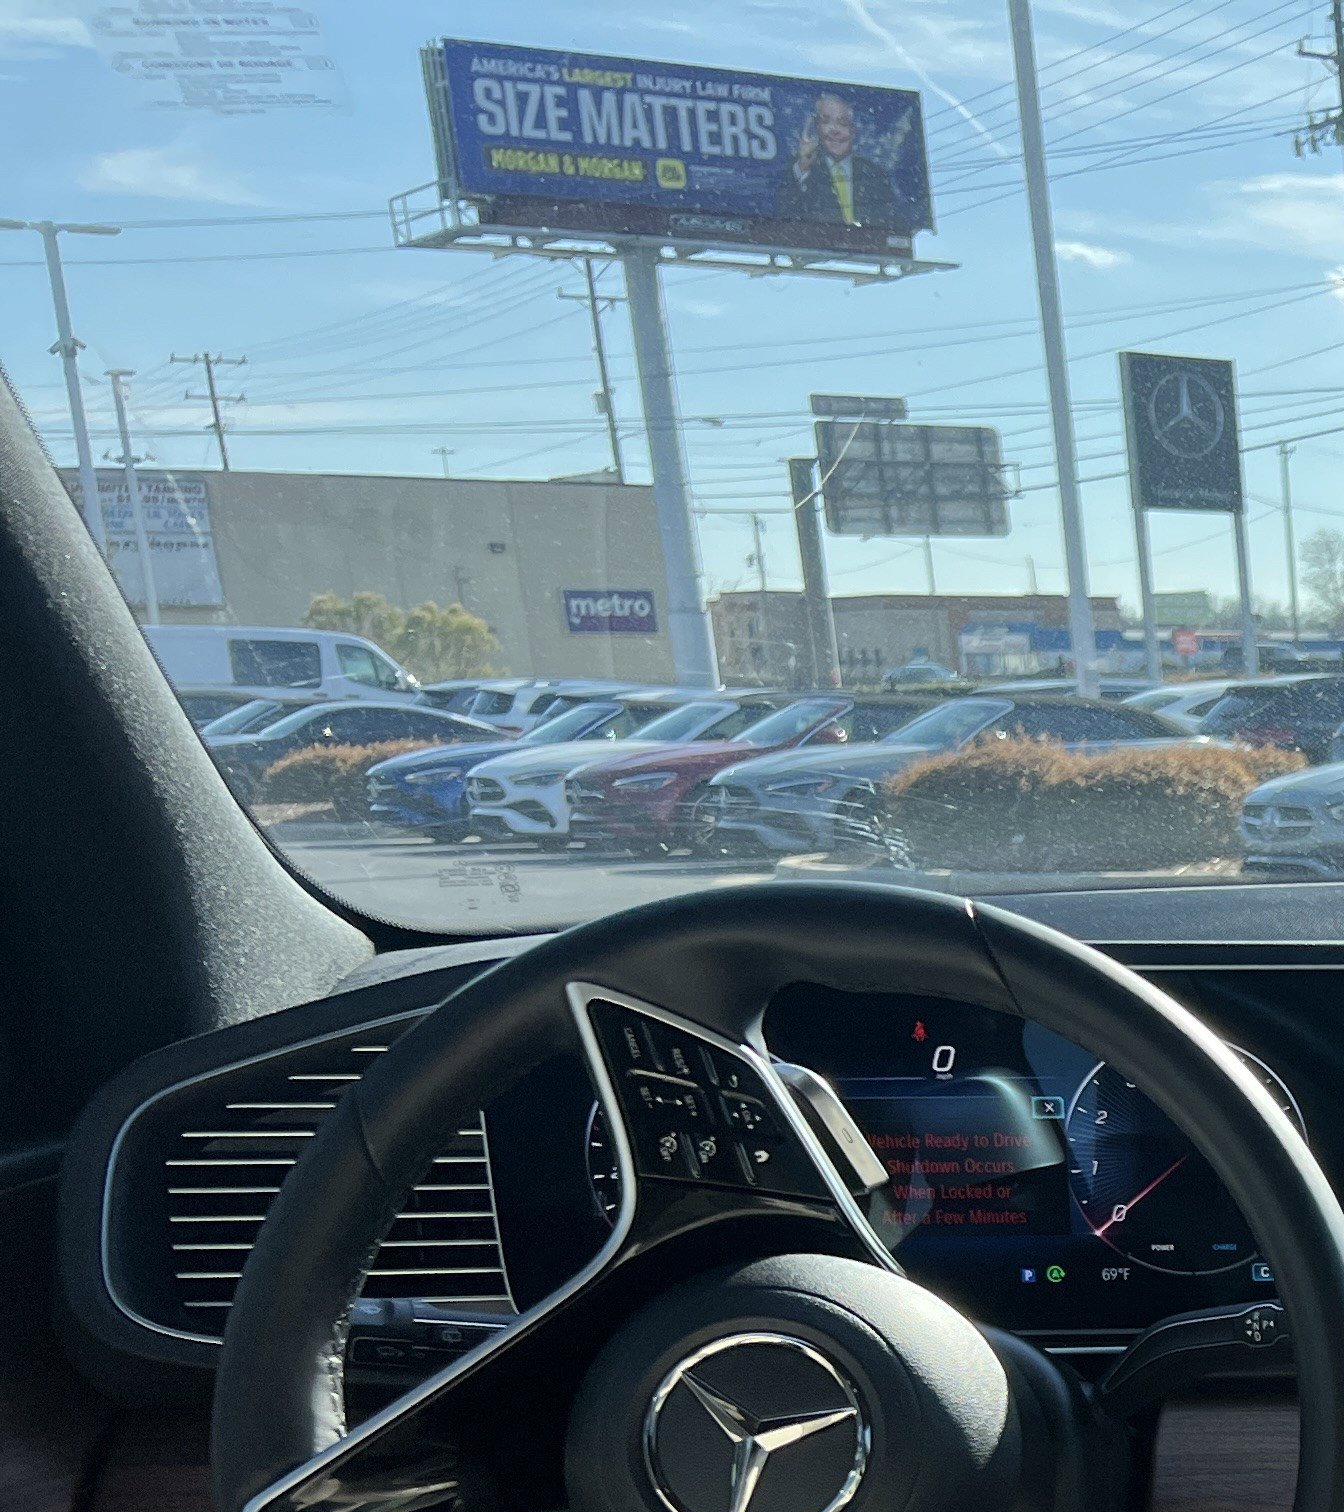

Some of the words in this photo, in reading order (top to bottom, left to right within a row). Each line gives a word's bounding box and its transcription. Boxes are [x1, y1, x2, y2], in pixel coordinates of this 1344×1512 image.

[470, 56, 560, 81] AMERICA'S
[472, 77, 573, 143] SIZE
[579, 89, 777, 161] MATTERS
[490, 148, 560, 174] MORGAN
[562, 153, 576, 176] &
[577, 155, 644, 182] MORGAN
[569, 593, 652, 618] metro
[931, 1045, 956, 1072] 0
[1094, 1110, 1108, 1125] 2
[925, 1133, 969, 1151] Ready
[974, 1134, 990, 1148] to
[994, 1133, 1032, 1148] Drive
[887, 1159, 960, 1174] Shutdown
[965, 1158, 1016, 1174] Occurs
[1092, 1160, 1099, 1176] 1
[894, 1184, 936, 1200] When
[941, 1184, 993, 1200] Locked
[997, 1186, 1013, 1200] or
[882, 1210, 918, 1225] After
[922, 1213, 931, 1225] a
[936, 1209, 964, 1225] Few
[969, 1209, 1028, 1225] Minutes
[1113, 1204, 1127, 1222] 0
[1259, 1266, 1271, 1278] C
